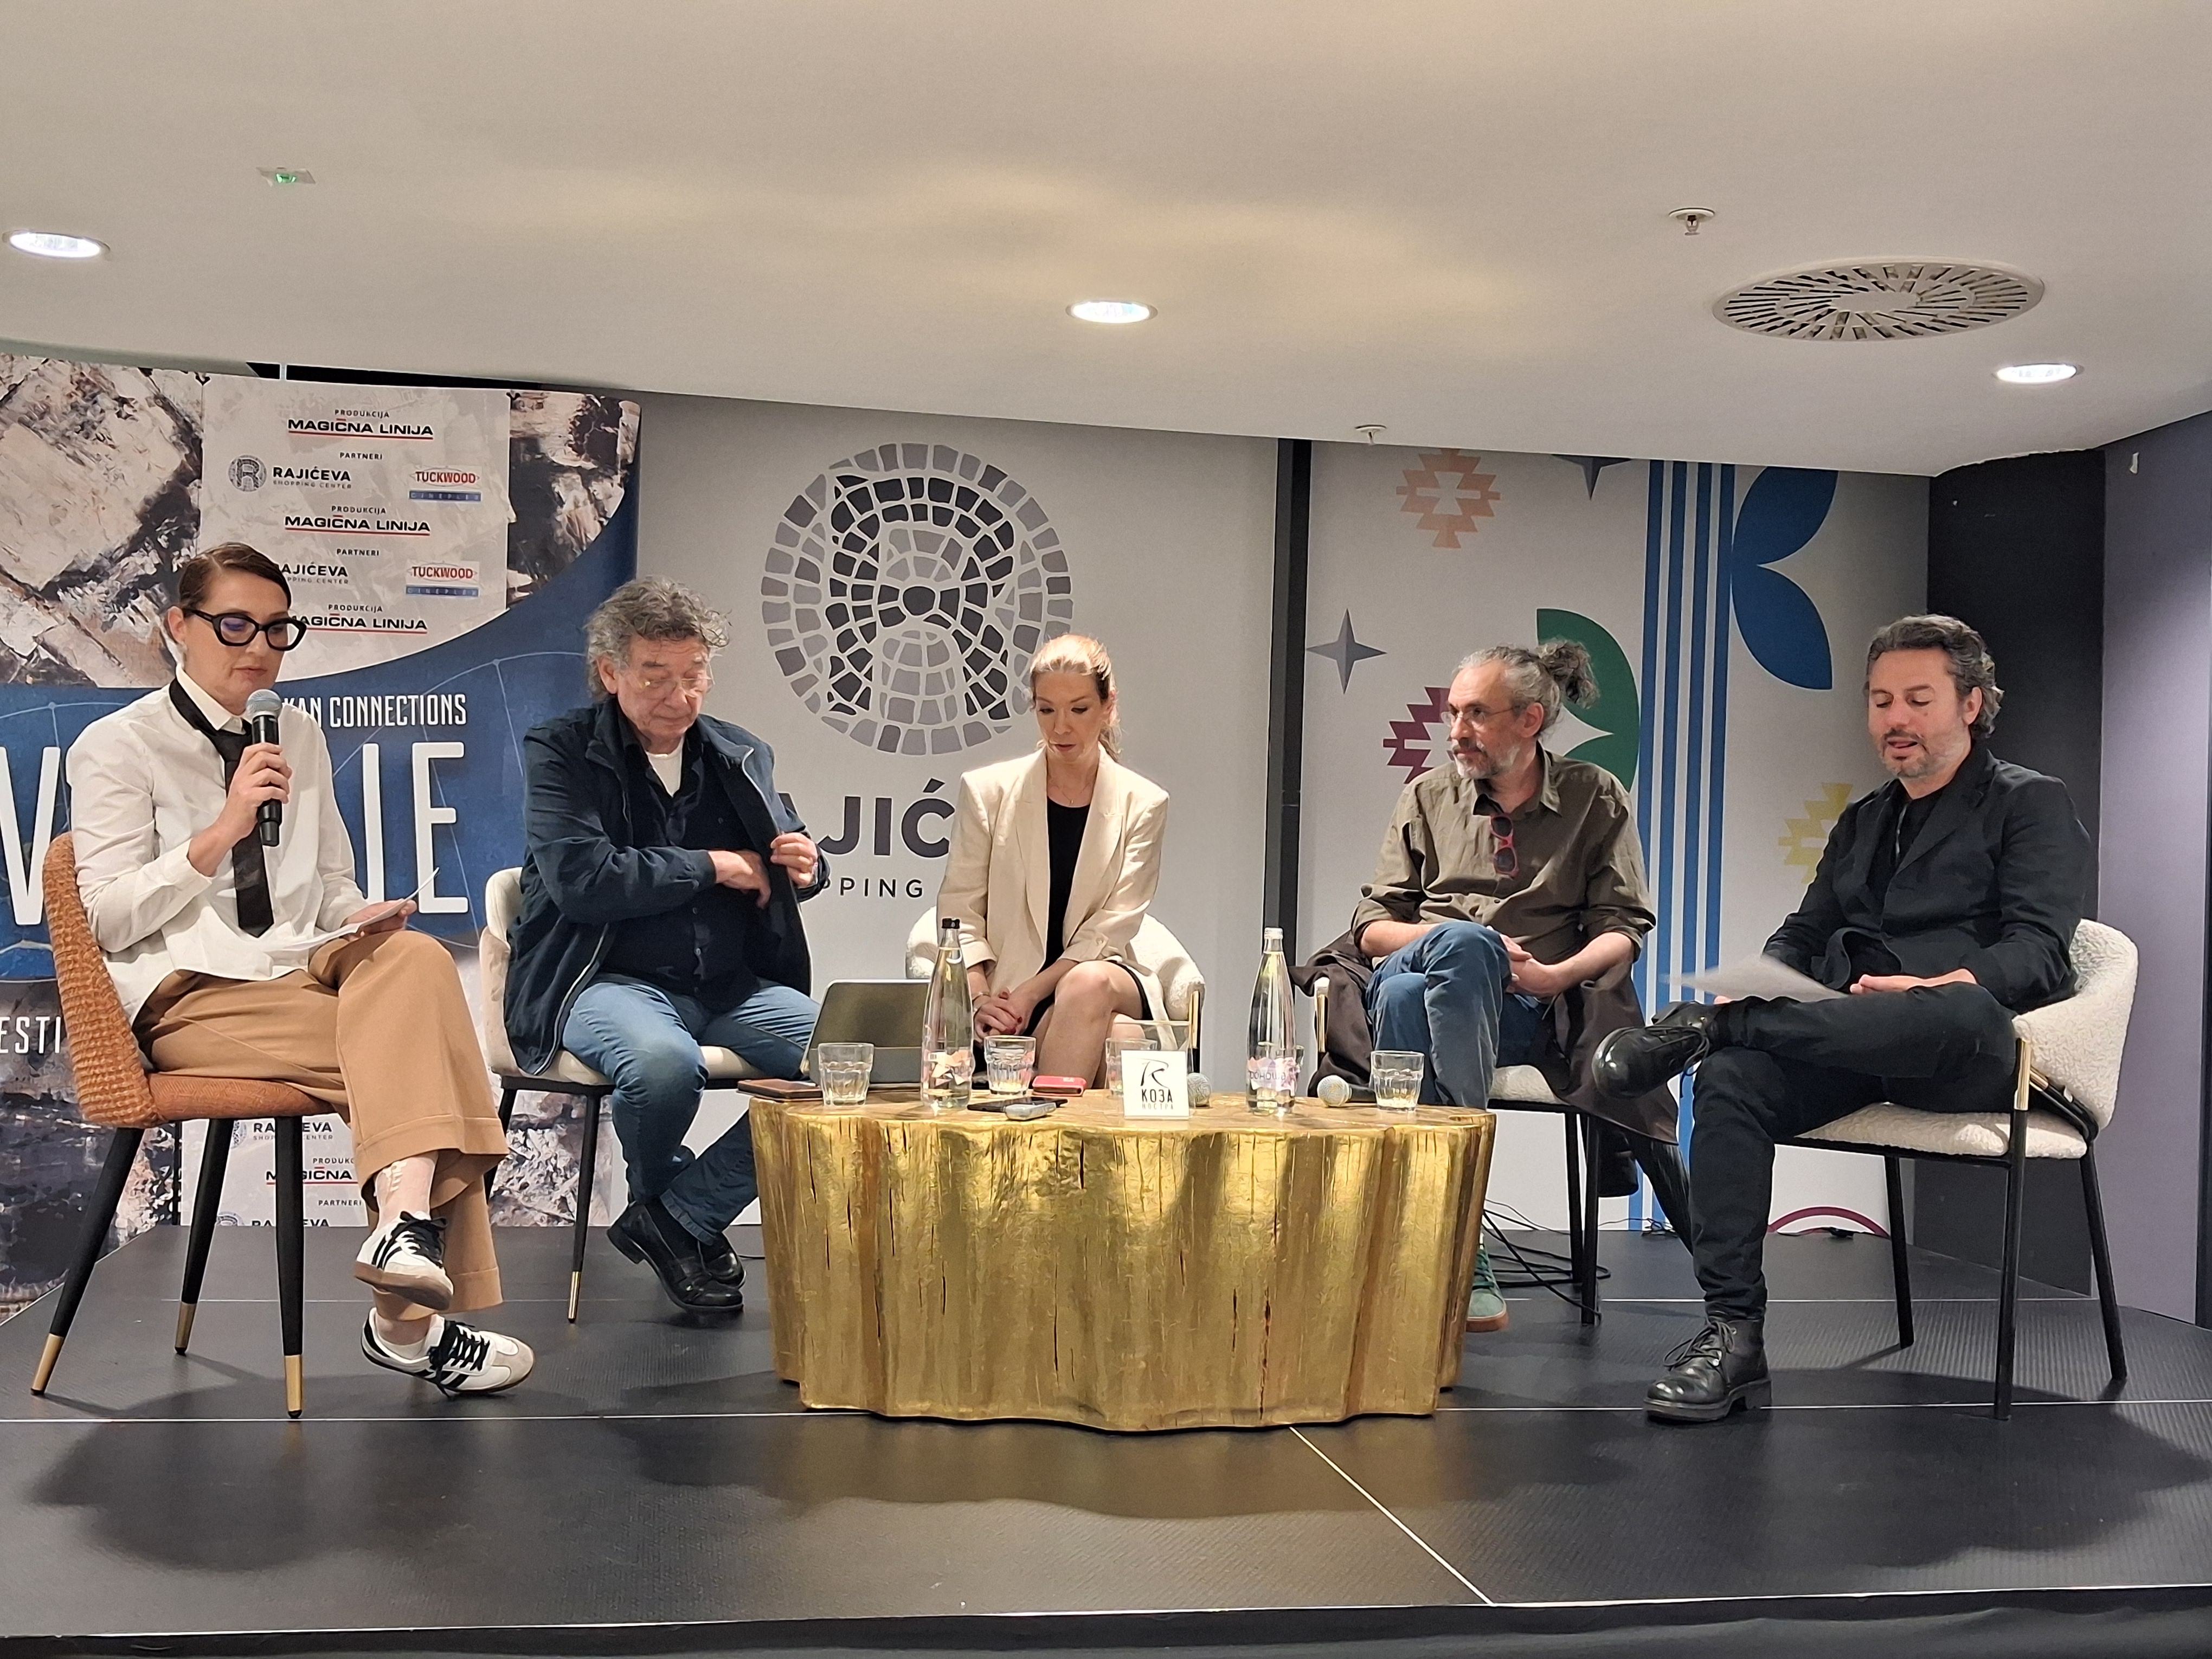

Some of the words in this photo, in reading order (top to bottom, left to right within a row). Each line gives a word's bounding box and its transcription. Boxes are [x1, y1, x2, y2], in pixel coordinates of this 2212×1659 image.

[335, 409, 390, 419] PRODUKCIJA
[380, 424, 434, 435] LINIJA
[339, 452, 383, 460] PARTNERI
[273, 466, 351, 481] RAJIĆEVA
[415, 471, 476, 484] TUCKWOOD
[331, 505, 386, 515] PRODUKCIJA
[376, 520, 430, 532] LINIJA
[336, 548, 380, 556] PARTNERI
[281, 561, 348, 577] AJIĆEVA
[412, 566, 473, 578] TUCKWOOD
[328, 604, 383, 613] PRODUKCIJA
[292, 613, 366, 627] AGIČNA
[372, 619, 427, 630] LINIJA
[329, 694, 466, 728] CONNECTIONS
